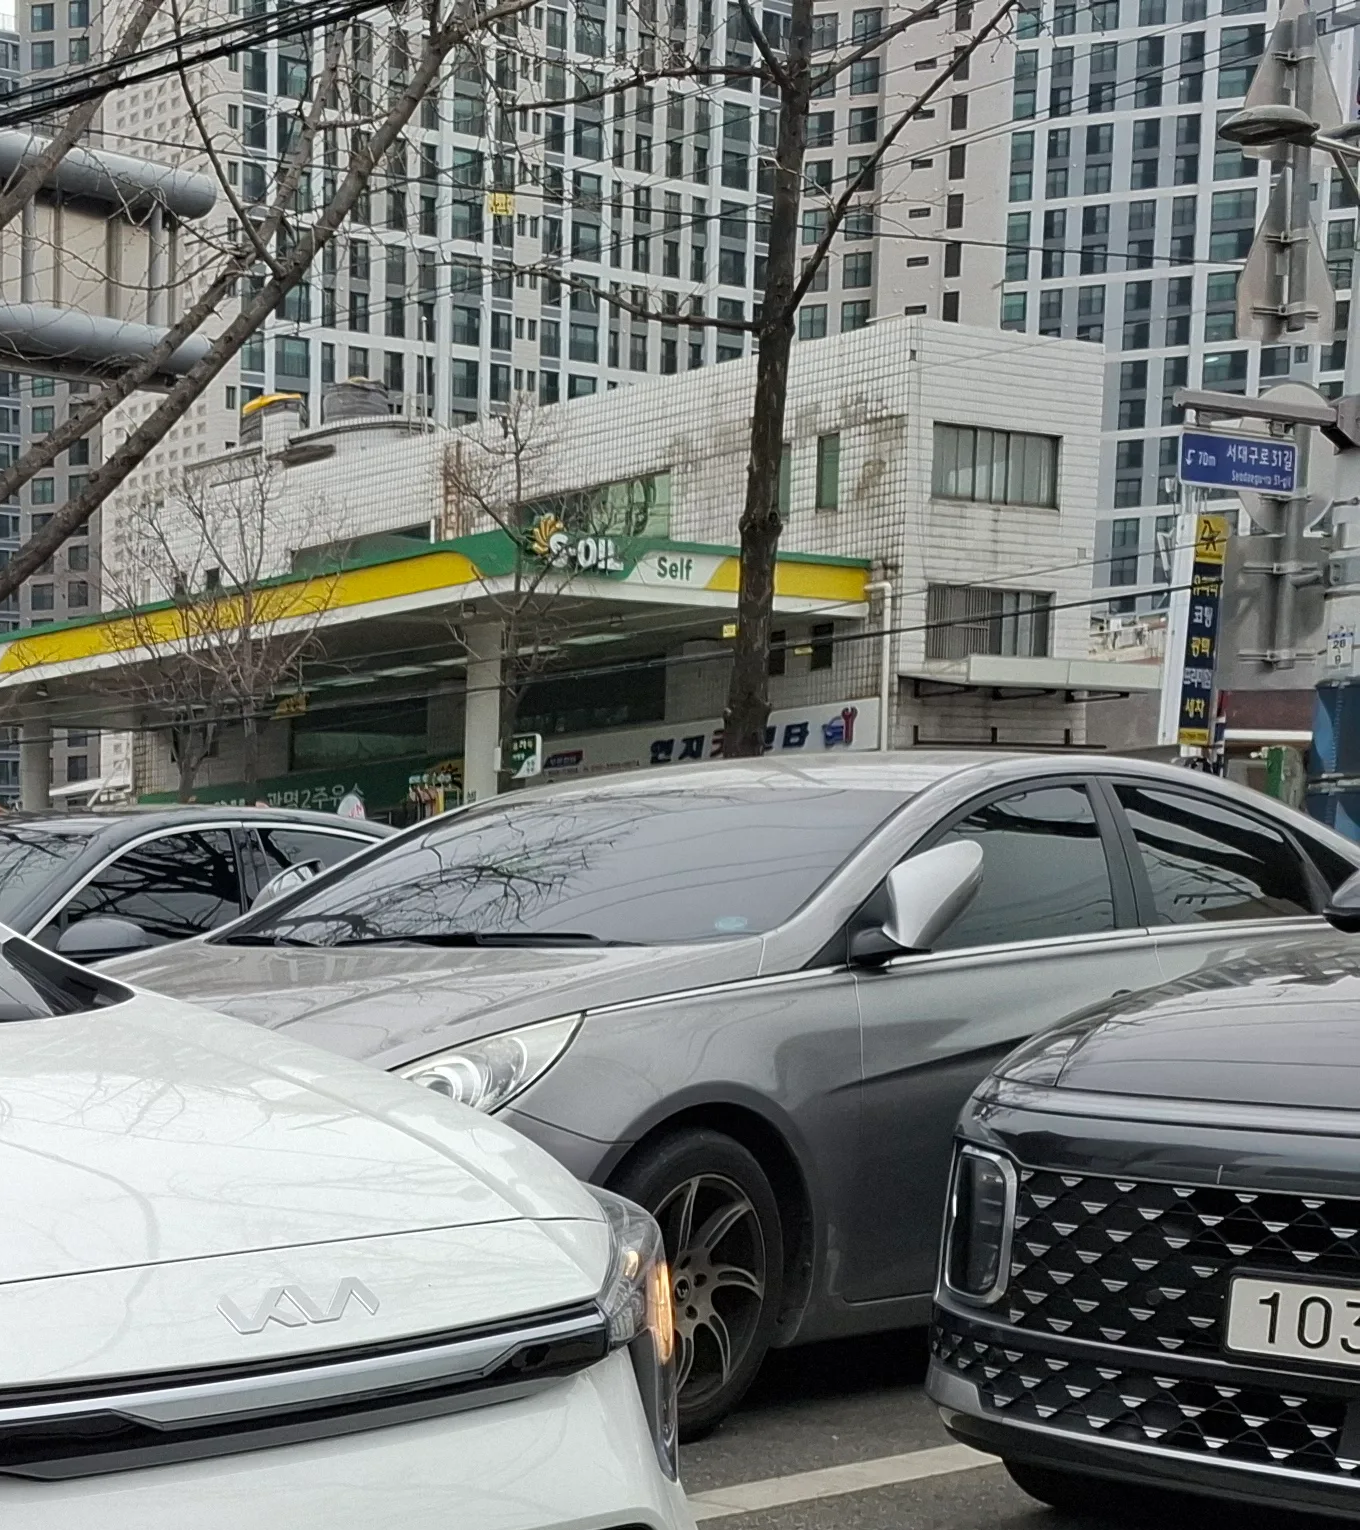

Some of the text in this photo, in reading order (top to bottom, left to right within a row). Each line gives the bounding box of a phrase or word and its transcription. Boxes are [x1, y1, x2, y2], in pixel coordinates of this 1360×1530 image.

[1198, 451, 1216, 467] 70m
[1226, 443, 1293, 472] 서대구로31길
[549, 533, 624, 572] S-OIL
[657, 556, 693, 581] Self
[216, 1276, 381, 1336] KIA
